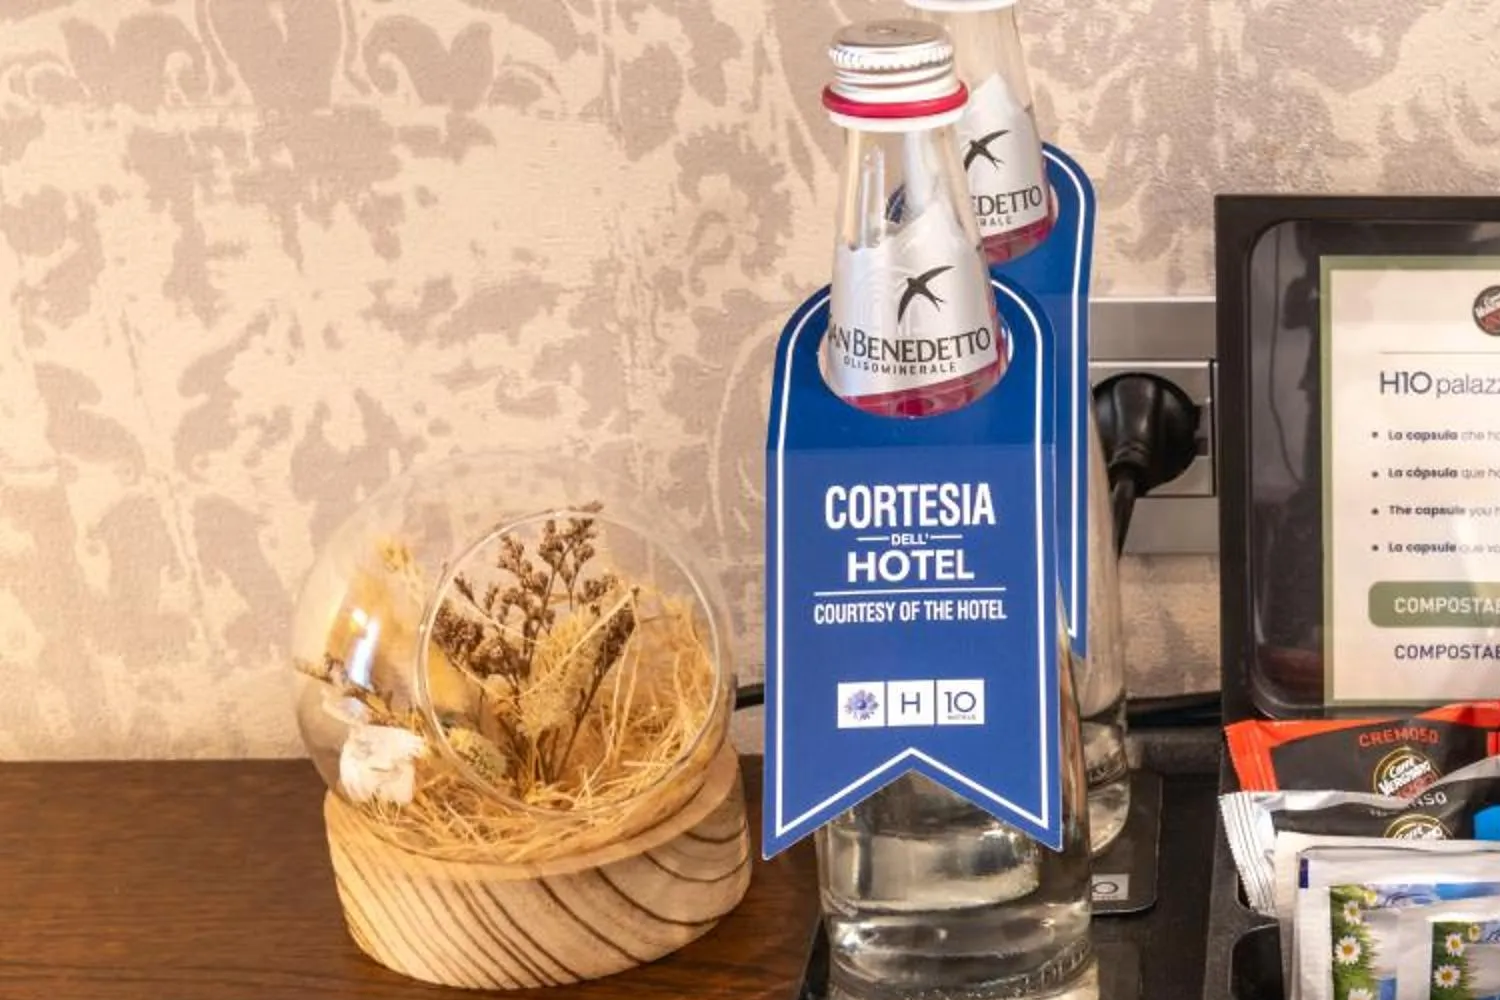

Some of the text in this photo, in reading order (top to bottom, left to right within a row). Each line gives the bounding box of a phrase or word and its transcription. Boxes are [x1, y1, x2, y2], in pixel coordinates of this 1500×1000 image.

[971, 185, 1043, 217] EDETTO
[843, 354, 957, 375] OLIGOMINERALE
[1387, 429, 1403, 441] La
[1405, 429, 1459, 443] capsula
[1387, 467, 1403, 478] La
[825, 482, 997, 530] CORTESIA
[1389, 504, 1412, 515] The
[1415, 505, 1466, 518] capsule
[1388, 541, 1403, 553] La
[1405, 541, 1457, 556] capsule
[847, 549, 976, 583] HOTEL
[814, 599, 1008, 624] COURTESY OF THE HOTEL
[1359, 726, 1440, 747] CREMOSO
